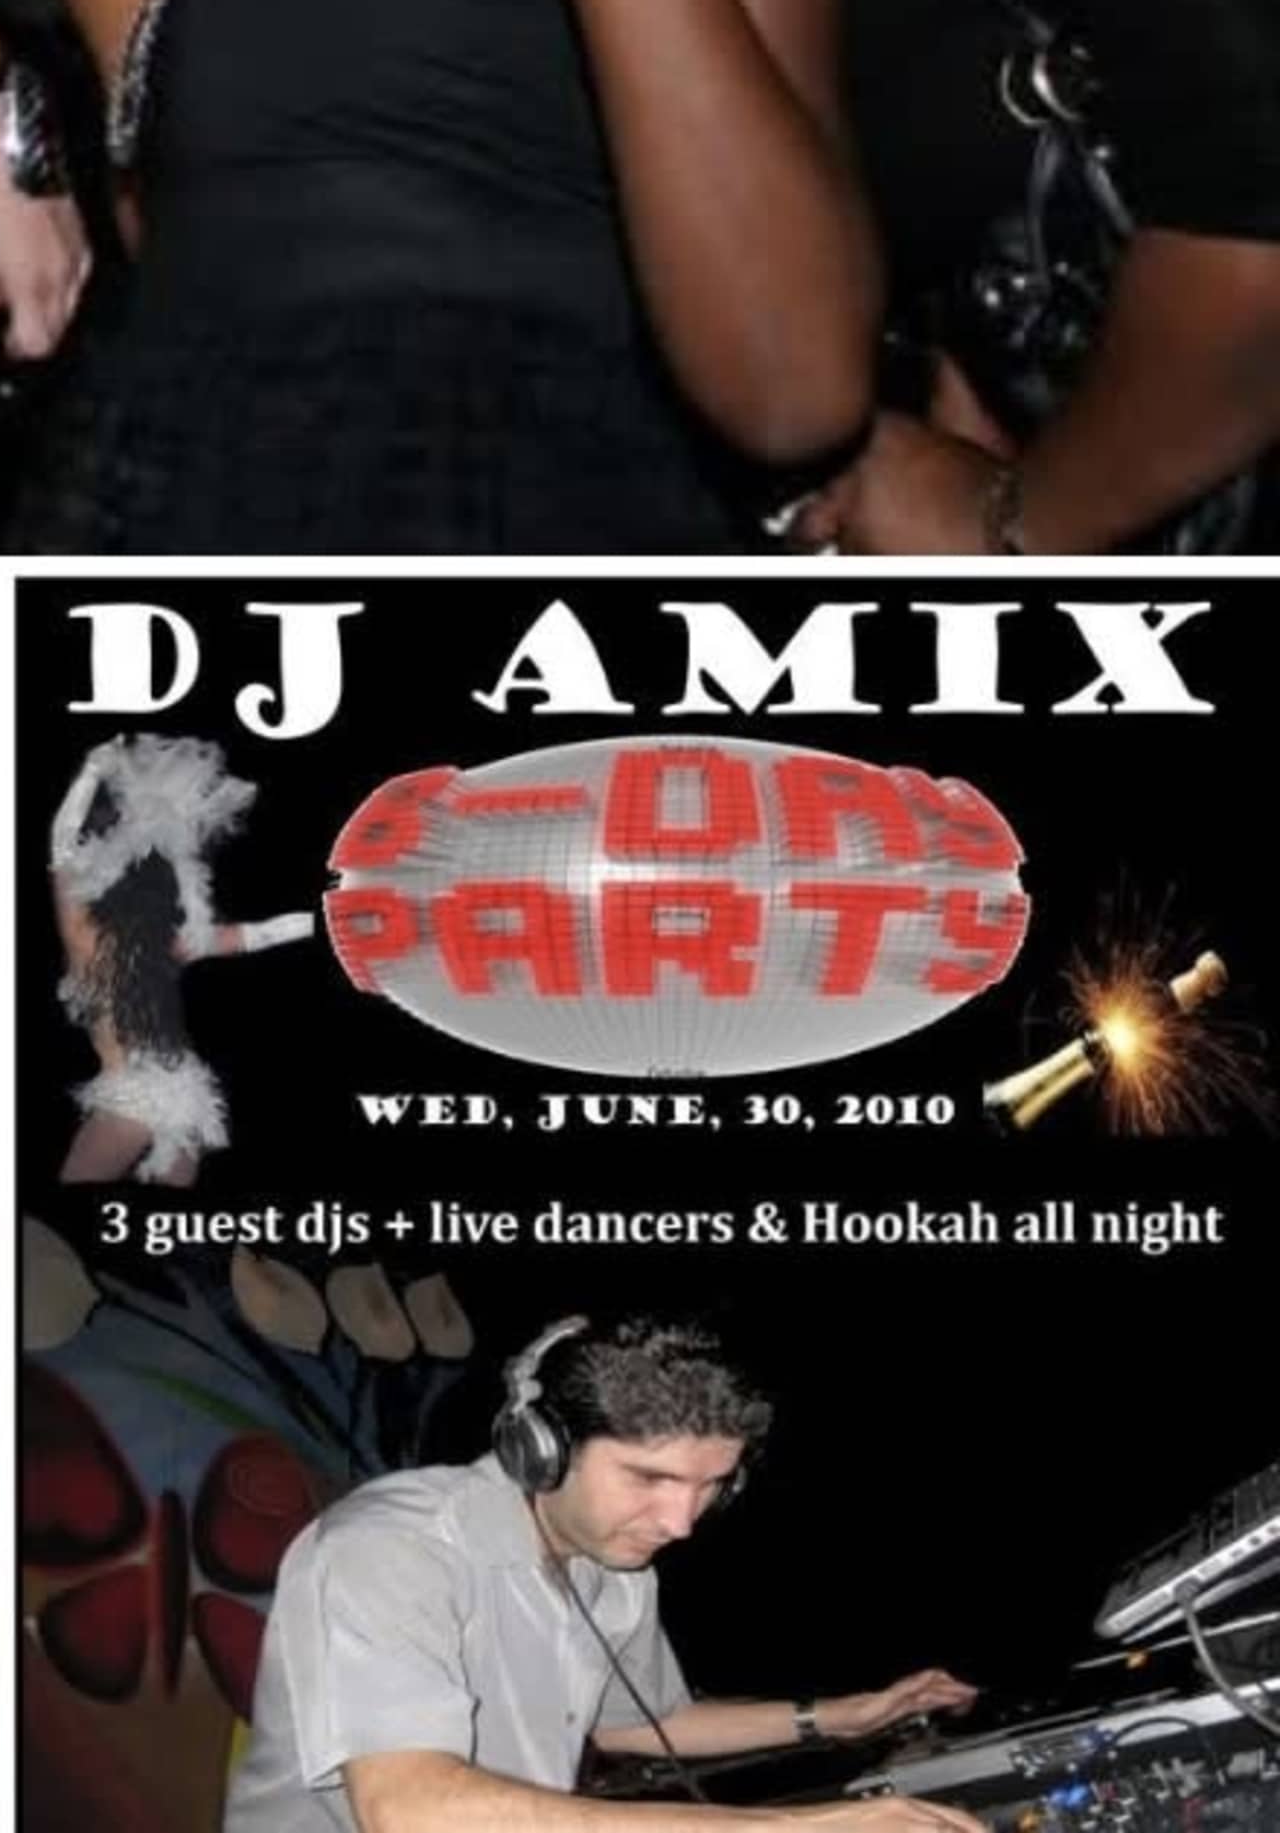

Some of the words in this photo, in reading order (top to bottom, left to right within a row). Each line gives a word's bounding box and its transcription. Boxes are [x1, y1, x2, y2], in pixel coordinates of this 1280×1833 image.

[67, 602, 365, 739] DJ
[472, 599, 1215, 715] AMIX
[324, 878, 1030, 996] PARTY
[357, 1094, 514, 1130] WED,
[537, 1094, 722, 1131] JUNE,
[744, 1094, 816, 1130] 30,
[835, 1094, 956, 1126] 2010
[100, 1201, 130, 1244] 3
[144, 1205, 283, 1256] guest
[295, 1200, 371, 1255] djs
[384, 1210, 415, 1240] +
[430, 1200, 520, 1244] live
[533, 1200, 735, 1244] dancers
[747, 1201, 789, 1244] &
[803, 1200, 999, 1244] Hookah
[1012, 1200, 1076, 1244] all
[1091, 1200, 1224, 1256] night
